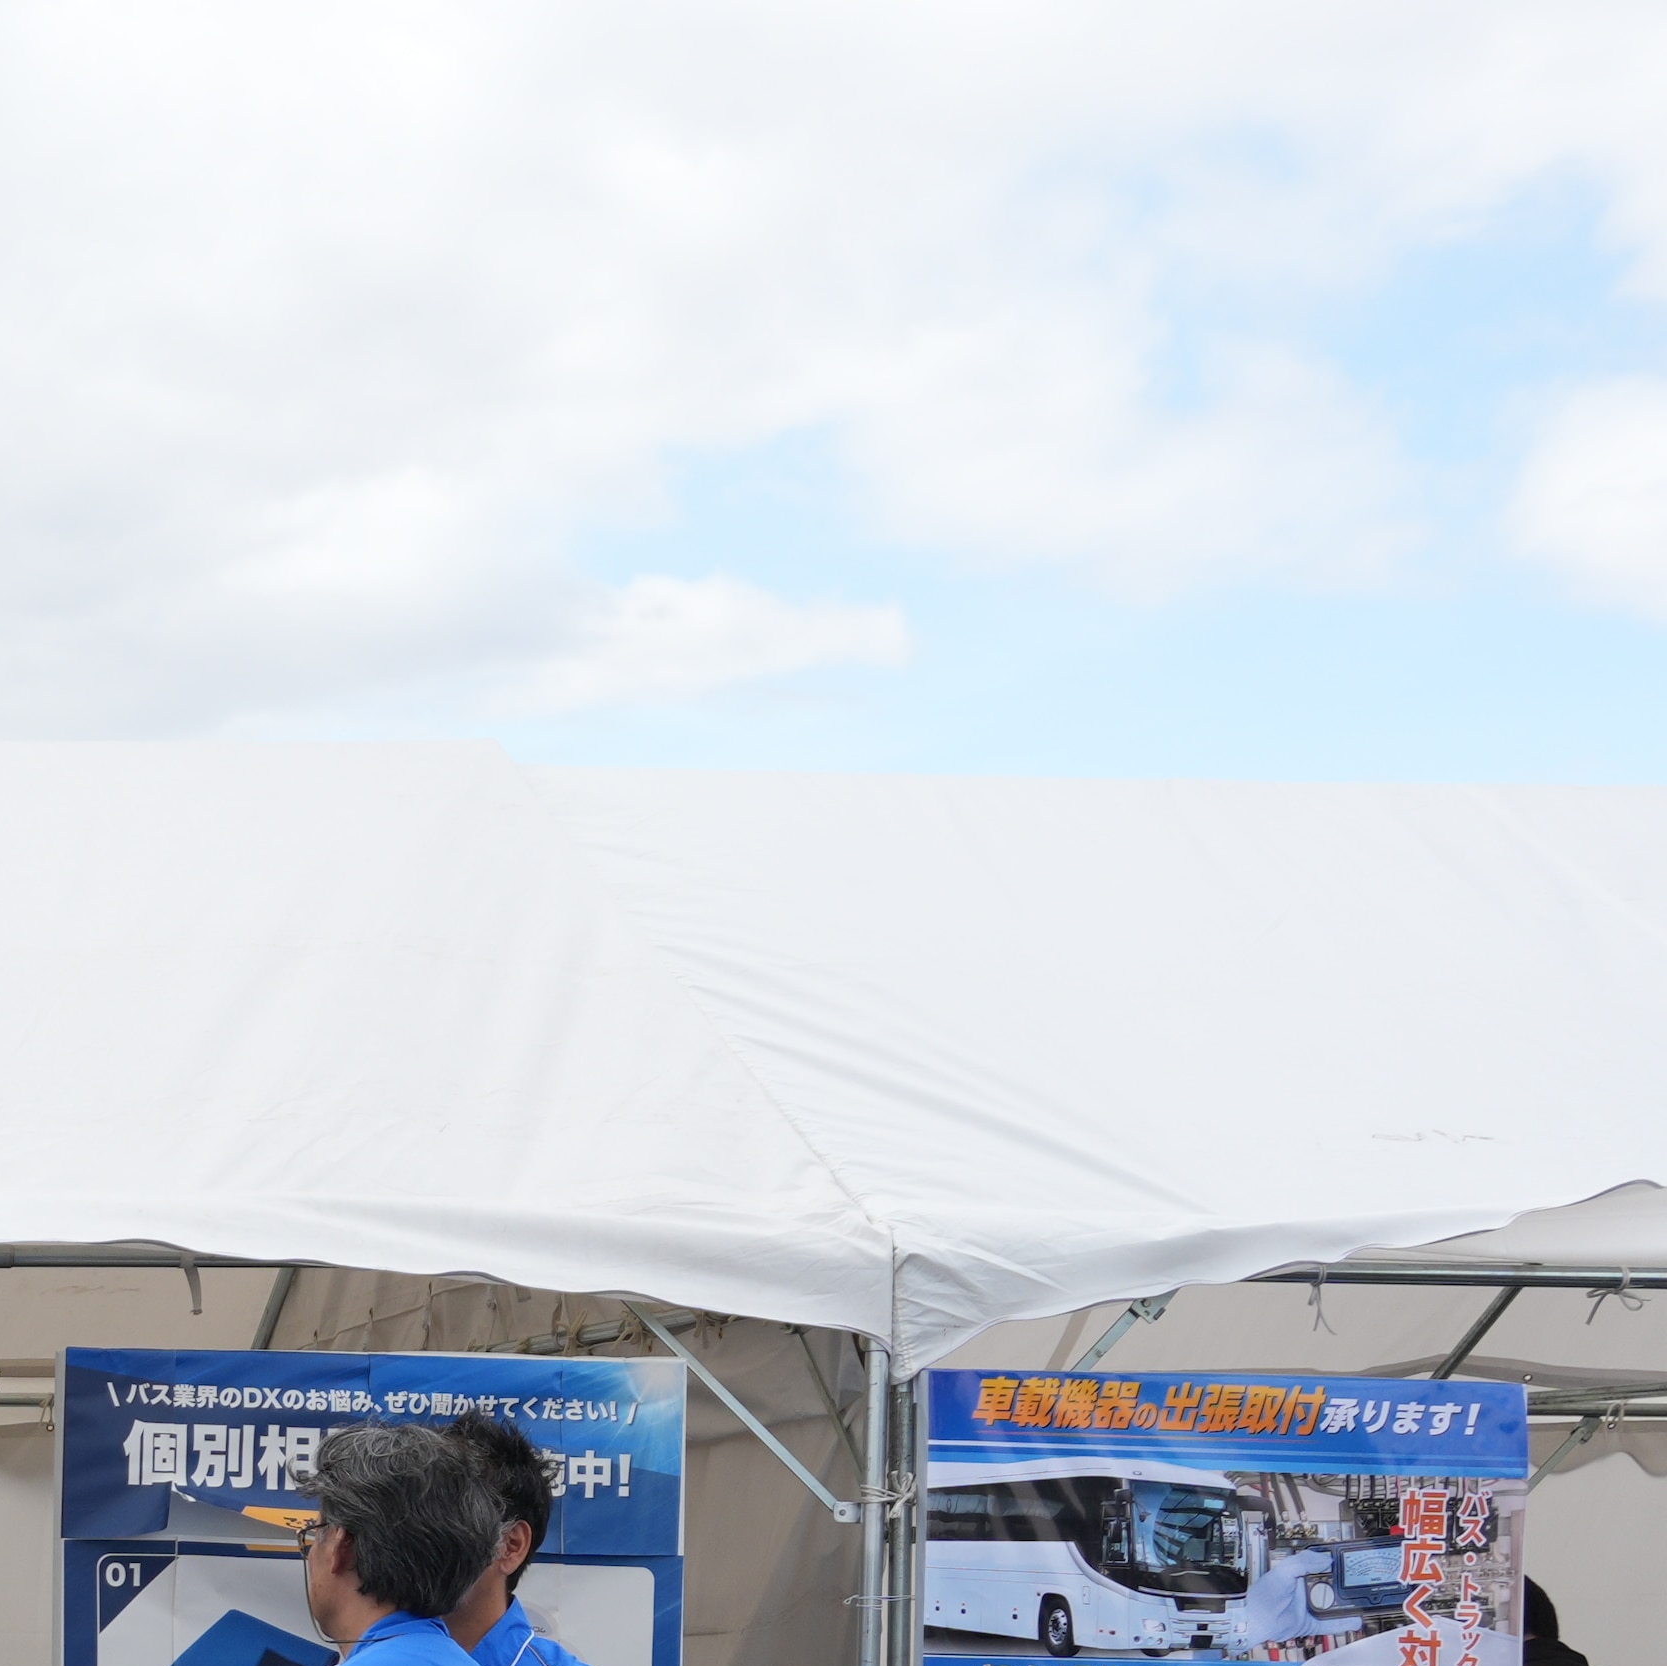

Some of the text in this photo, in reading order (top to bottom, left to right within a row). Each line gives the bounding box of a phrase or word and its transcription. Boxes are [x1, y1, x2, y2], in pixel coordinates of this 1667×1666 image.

[971, 1377, 1482, 1437] 車載機器の出張取付承ります!
[105, 1563, 141, 1587] 01
